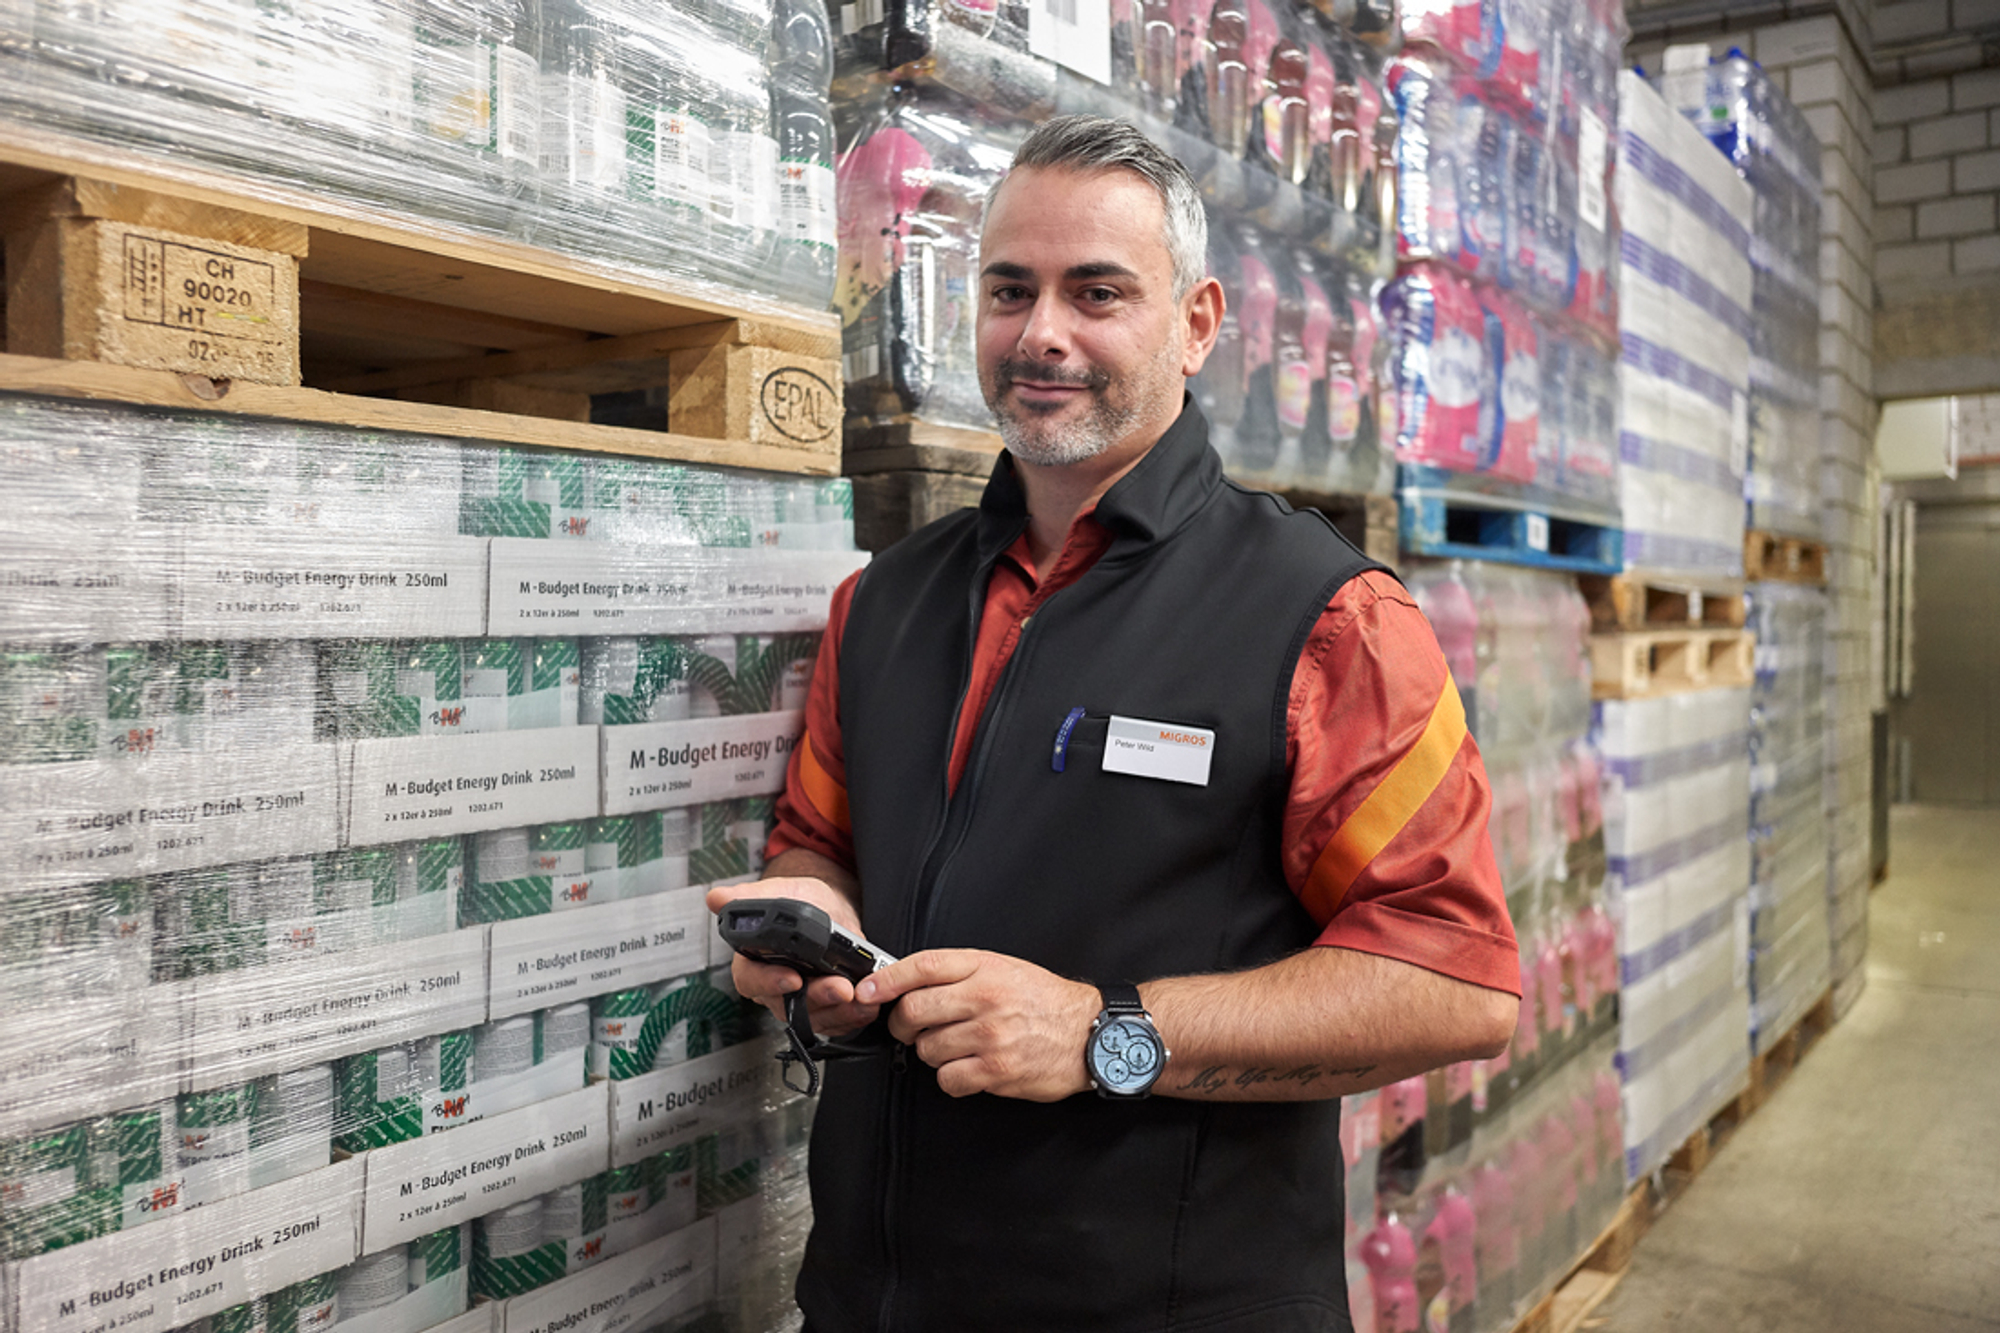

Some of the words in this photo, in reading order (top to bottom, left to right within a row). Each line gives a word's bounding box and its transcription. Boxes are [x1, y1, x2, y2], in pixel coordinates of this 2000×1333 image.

[205, 259, 234, 280] CH
[184, 278, 252, 307] 90020
[178, 305, 206, 325] HT
[774, 380, 828, 430] EPAL
[305, 571, 356, 590] Energy
[360, 572, 398, 587] Drink
[405, 573, 448, 588] 250ml
[583, 582, 620, 598] Energy
[557, 609, 580, 617] 250ml
[722, 739, 772, 761] Energy
[775, 733, 797, 753] Dri
[1114, 739, 1136, 749] Peter
[1137, 743, 1154, 752] Wild
[1159, 731, 1207, 746] MIGROS
[456, 774, 498, 791] Energy
[501, 769, 533, 786] Drink
[539, 765, 575, 782] 250ml
[629, 786, 634, 796] 2
[643, 783, 660, 794] 12er
[668, 779, 692, 791] 250ml
[202, 798, 246, 818] Drink
[255, 791, 304, 811] 250ml
[384, 813, 390, 822] 2
[401, 811, 419, 820] 12er
[428, 806, 453, 818] 250ml
[580, 944, 617, 963] Energy
[620, 936, 648, 953] Drink
[653, 928, 686, 946] 250ml
[375, 981, 411, 1002] Drink
[419, 971, 461, 993] 250ml
[471, 1153, 512, 1175] Energy
[514, 1139, 546, 1160] Drink
[552, 1125, 587, 1148] 250ml
[399, 1212, 405, 1221] 2
[414, 1204, 433, 1217] 12er
[442, 1192, 467, 1209] 250ml
[158, 1254, 216, 1285] Energy
[221, 1237, 263, 1263] Drink
[272, 1216, 320, 1245] 250ml
[628, 1276, 656, 1298] Drink
[661, 1259, 693, 1284] 250ml
[119, 1304, 154, 1326] 250ml
[176, 1281, 223, 1305] 1202.671
